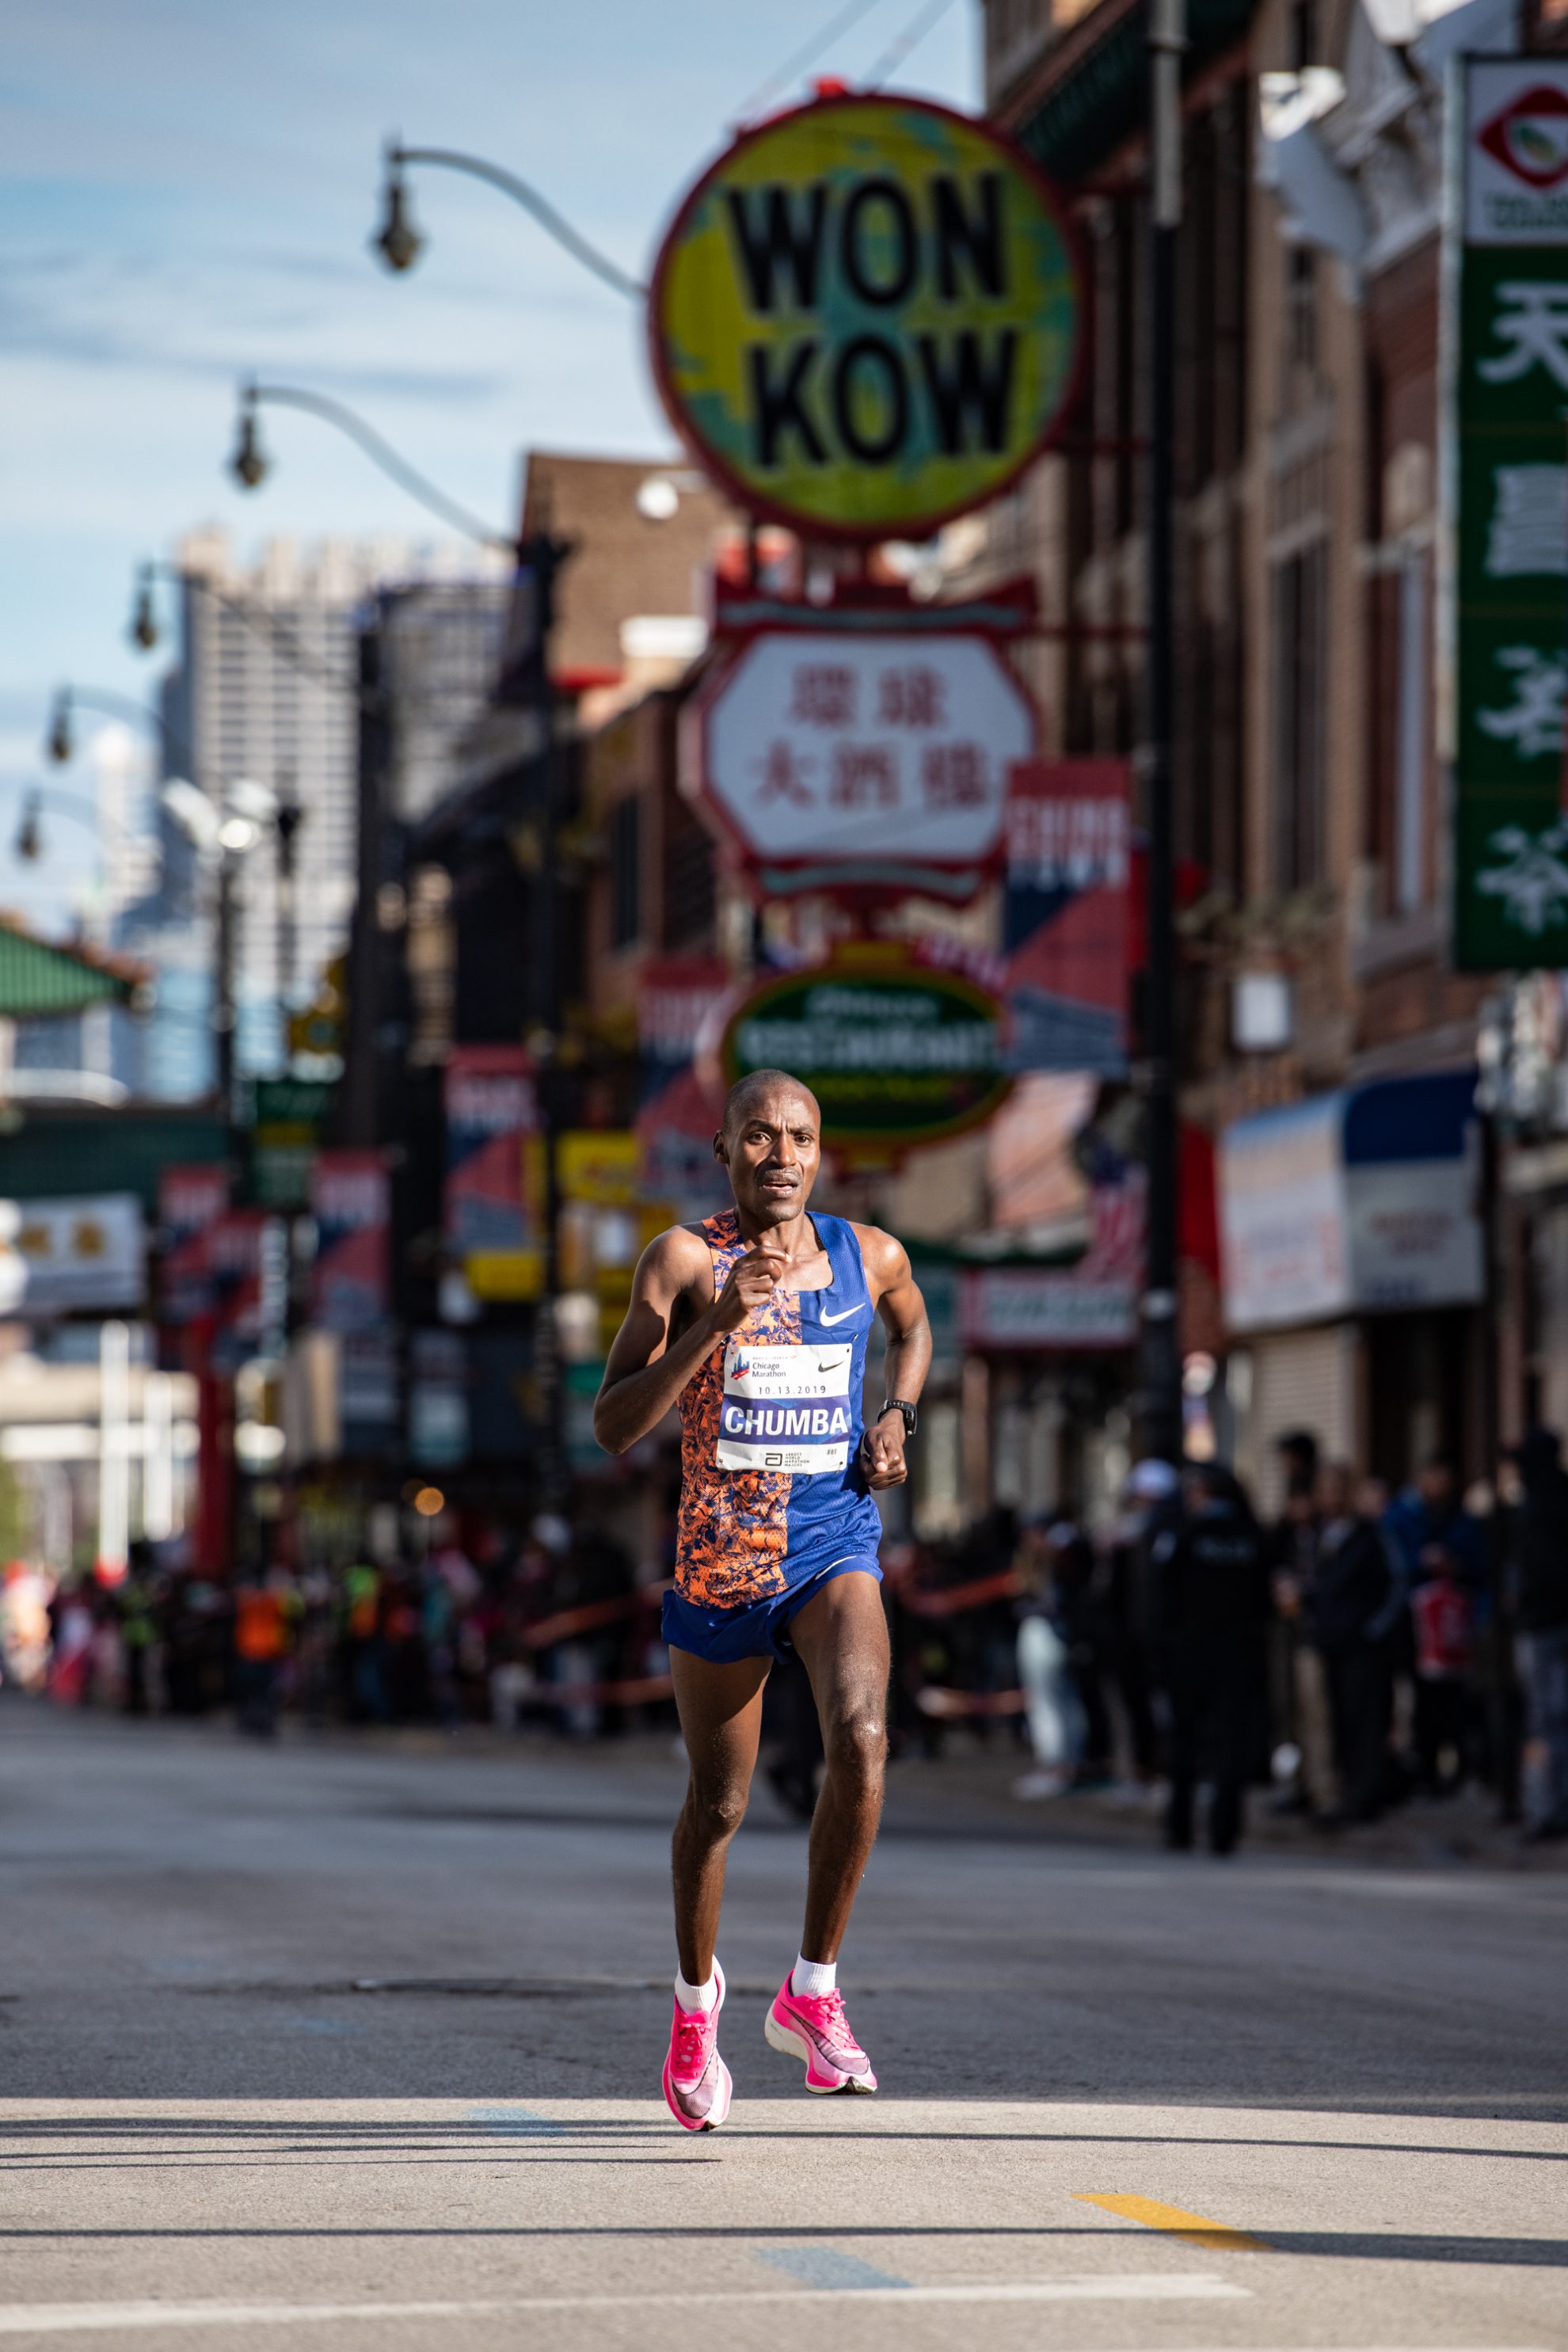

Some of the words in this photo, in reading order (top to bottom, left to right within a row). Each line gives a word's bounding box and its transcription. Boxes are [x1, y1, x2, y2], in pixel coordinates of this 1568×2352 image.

[726, 169, 1006, 312] WON
[750, 326, 1018, 470] KOW
[752, 1362, 780, 1371] Chicago
[759, 1385, 826, 1395] 10.13.2019
[725, 1406, 849, 1437] CHUMBA
